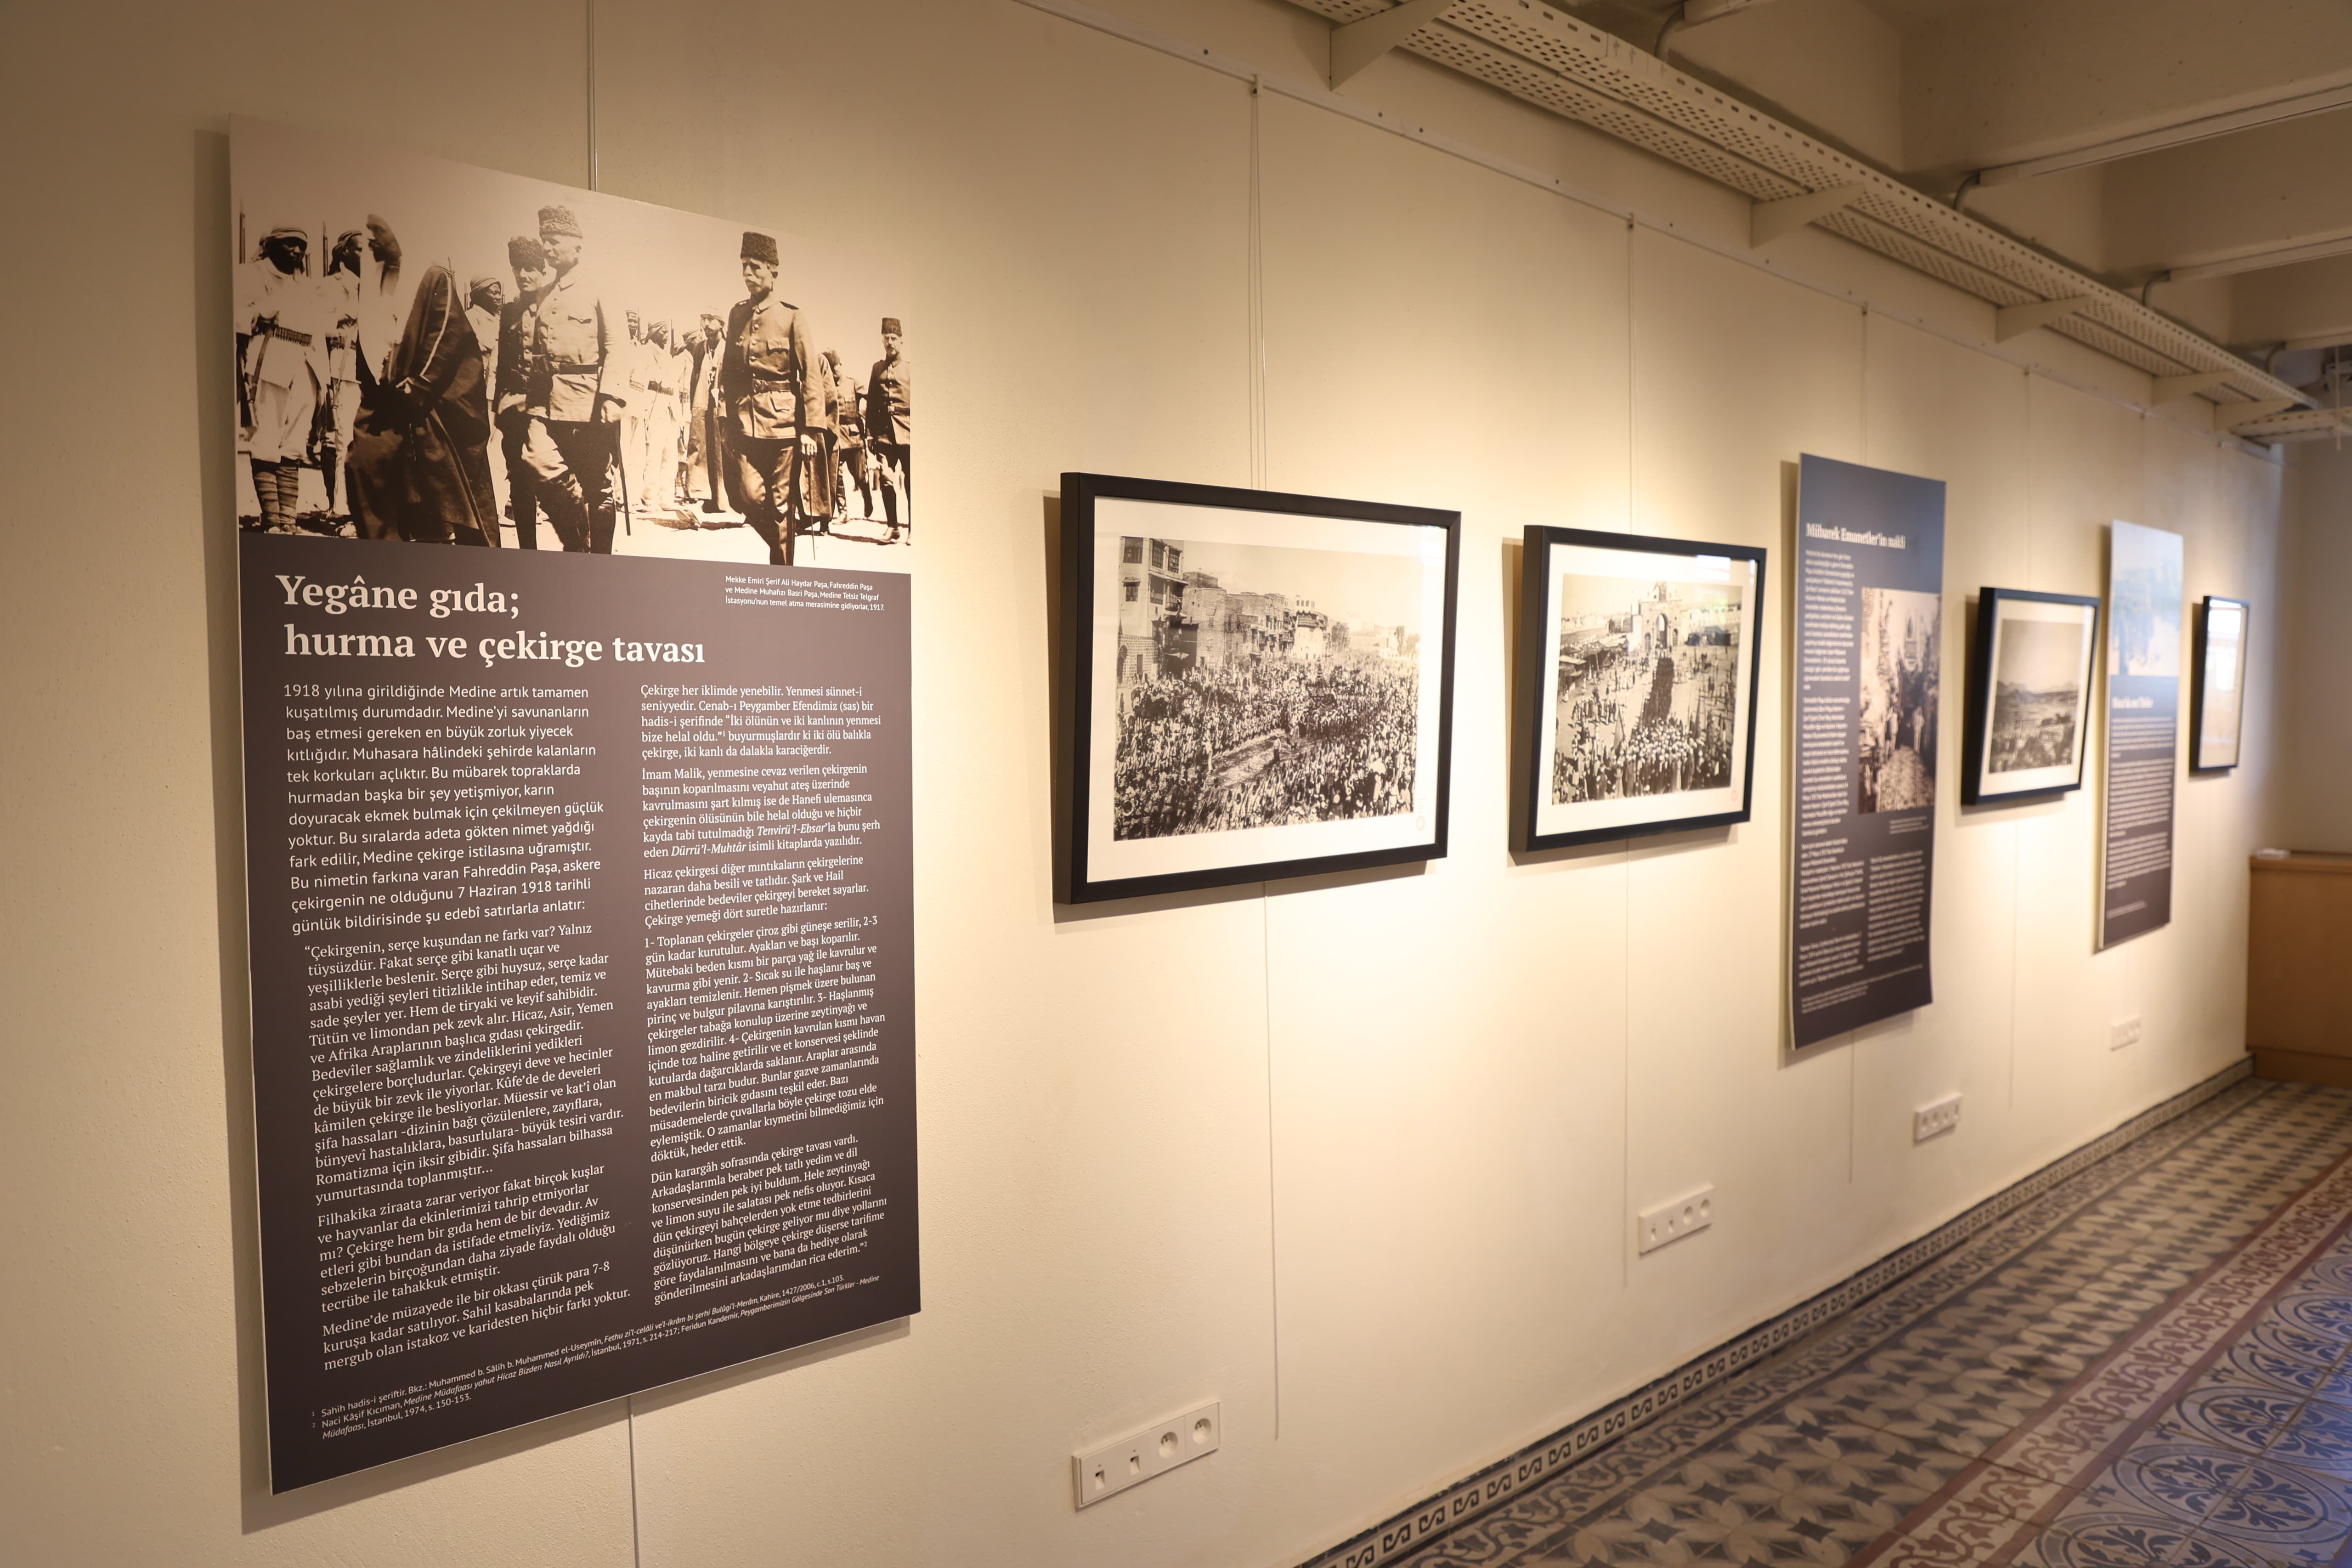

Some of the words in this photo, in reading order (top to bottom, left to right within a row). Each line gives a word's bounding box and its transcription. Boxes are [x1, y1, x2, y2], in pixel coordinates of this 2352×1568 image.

[275, 575, 417, 614] Yegâne
[430, 582, 518, 619] gıda;
[725, 575, 746, 583] Mekke
[747, 576, 764, 584] Emiri
[765, 577, 780, 586] Şerif
[791, 578, 813, 588] Haydar
[814, 580, 829, 589] Paşa,
[829, 581, 859, 590] Fahreddin
[859, 583, 873, 592] Paşa
[734, 586, 758, 594] Medine
[759, 587, 786, 596] Muhafızı
[787, 589, 803, 597] Basri
[803, 589, 820, 599] Paşa,
[820, 590, 842, 599] Medine
[859, 593, 879, 602] Telgraf
[805, 600, 840, 609] merasimine
[840, 602, 869, 611] gidiyorlar,
[283, 623, 415, 657] hurma
[425, 637, 467, 658] ve
[479, 630, 602, 668] çekirge
[612, 637, 705, 662] tavası
[283, 684, 319, 696] 1918
[324, 684, 362, 700] yılına
[367, 685, 445, 700] girildiğinde
[449, 685, 496, 697] Medine
[500, 685, 529, 698] artık
[531, 687, 588, 698] tamamen
[640, 684, 679, 698] Çekirge
[681, 684, 699, 696] her
[701, 684, 738, 696] iklimde
[739, 685, 784, 698] yenebilir.
[785, 685, 823, 696] Yenmesi
[825, 686, 862, 696] sünnet-i
[286, 705, 358, 721] kuşatılmış
[362, 705, 443, 718] durumdadır.
[511, 705, 589, 718] savunanların
[641, 767, 672, 780] İmam
[673, 767, 705, 780] Malik,
[706, 766, 759, 781] yenmesine
[761, 768, 787, 776] cevaz
[788, 764, 820, 776] verilen
[821, 763, 867, 777] çekirgenin
[288, 810, 361, 827] doyuracak
[364, 808, 409, 822] ekmek
[413, 806, 462, 820] bulmak
[465, 805, 488, 821] için
[492, 804, 560, 820] çekilmeyen
[564, 801, 604, 816] güçlük
[292, 917, 341, 936] günlük
[345, 911, 421, 928] bildirisinde
[425, 911, 440, 925] şu
[444, 905, 480, 920] edebî
[484, 902, 539, 917] satırlarla
[542, 900, 585, 912] anlatır:
[644, 914, 683, 929] Çekirge
[684, 909, 721, 925] yemeği
[723, 908, 744, 919] dört
[746, 904, 778, 917] suretle
[780, 901, 827, 914] hazırlanır:
[308, 959, 376, 977] tüysüzdür.
[379, 956, 413, 969] Fakat
[416, 954, 448, 967] serçe
[451, 949, 473, 965] gibi
[476, 945, 516, 960] kanatlı
[519, 945, 544, 958] uçar
[546, 944, 560, 953] ve
[311, 1063, 372, 1081] Bedevîler
[375, 1054, 435, 1074] sağlamlık
[436, 1054, 451, 1064] ve
[454, 1041, 531, 1062] zindeliklerini
[534, 1034, 582, 1054] yedikleri
[648, 1069, 697, 1087] kutularda
[699, 1059, 763, 1079] dağarcıklarda
[765, 1054, 804, 1068] saklanır.
[805, 1047, 839, 1061] Araplar
[840, 1041, 876, 1056] arasında
[650, 1171, 673, 1183] Dün
[674, 1160, 718, 1179] karargâh
[720, 1151, 769, 1170] sofrasında
[770, 1146, 804, 1162] çekirge
[805, 1140, 832, 1153] tavası
[833, 1133, 858, 1147] vardı.
[322, 1336, 367, 1353] kuruşa
[369, 1326, 405, 1342] kadar
[407, 1314, 459, 1333] satılıyor.
[462, 1303, 492, 1320] Sahil
[494, 1285, 571, 1313] kasabalarında
[574, 1279, 594, 1296] pek
[321, 1404, 345, 1417] Sahih
[347, 1395, 376, 1410] hadis-i
[378, 1388, 407, 1404] şeriftir.
[408, 1384, 427, 1394] Bkz.:
[429, 1370, 475, 1389] Muhammed
[485, 1363, 505, 1374] Sâlih
[515, 1348, 559, 1366] Muhammed
[604, 1333, 623, 1343] Fethu
[687, 1313, 694, 1321] bi
[694, 1308, 711, 1321] şerhi
[759, 1291, 781, 1303] Kahire,
[781, 1282, 817, 1297] 1427/2006,
[322, 1416, 341, 1428] Naci
[343, 1409, 365, 1423] Kâşif
[366, 1402, 402, 1416] Kıcıman,
[403, 1393, 432, 1407] Medine
[433, 1383, 473, 1398] Müdafaası
[473, 1376, 495, 1390] yahut
[496, 1371, 517, 1382] Hicaz
[518, 1364, 542, 1376] Bizden
[543, 1357, 562, 1369] Nasıl
[562, 1350, 590, 1365] Ayrıldı?,
[591, 1342, 622, 1357] İstanbul,
[622, 1337, 642, 1348] 1971,
[649, 1327, 680, 1341] 214-217;
[681, 1321, 707, 1333] Feridun
[707, 1312, 740, 1325] Kandemir,
[740, 1298, 791, 1317] Peygamberimizin
[791, 1289, 823, 1303] Gölgesinde
[836, 1281, 855, 1291] Türkler
[859, 1275, 880, 1285] Medine
[322, 1423, 366, 1440] Müdafaası,
[367, 1411, 403, 1427] İstanbul,
[404, 1404, 427, 1417] 1974,
[435, 1393, 471, 1409] 150-153.
